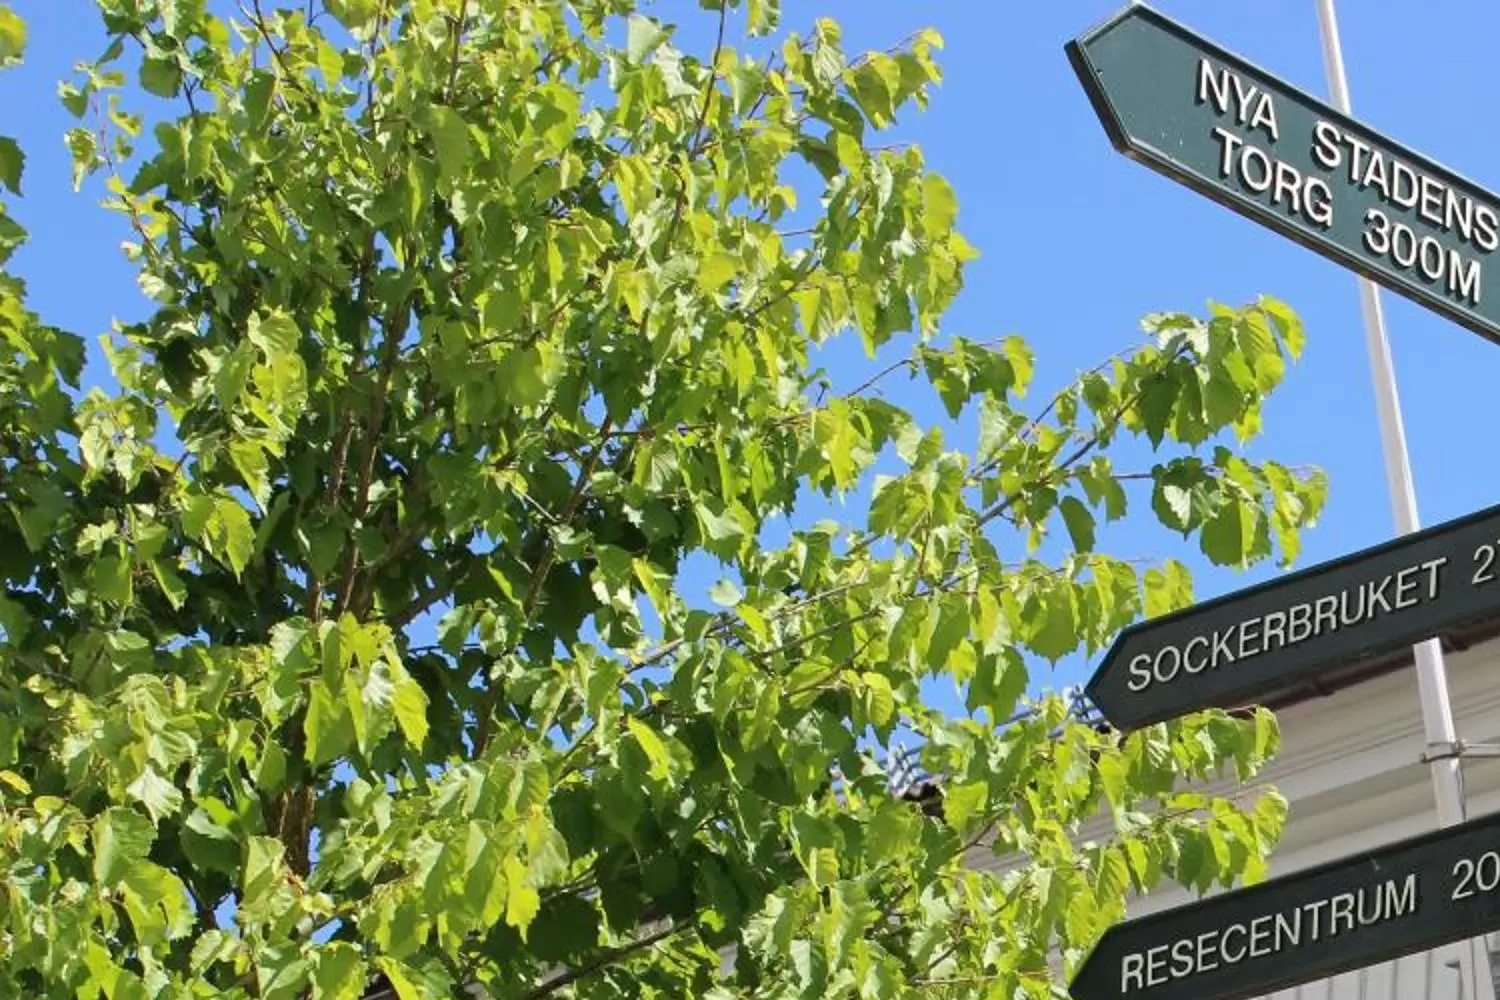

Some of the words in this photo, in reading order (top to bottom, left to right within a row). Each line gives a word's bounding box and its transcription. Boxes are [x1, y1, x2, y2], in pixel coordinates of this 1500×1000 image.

[1200, 59, 1279, 139] NYA
[1314, 121, 1500, 251] STADENS
[1213, 126, 1334, 227] TORG
[1364, 207, 1482, 303] 300M
[1127, 557, 1448, 692] SOCKERBRUKET
[1121, 873, 1416, 993] RESECENTRUM
